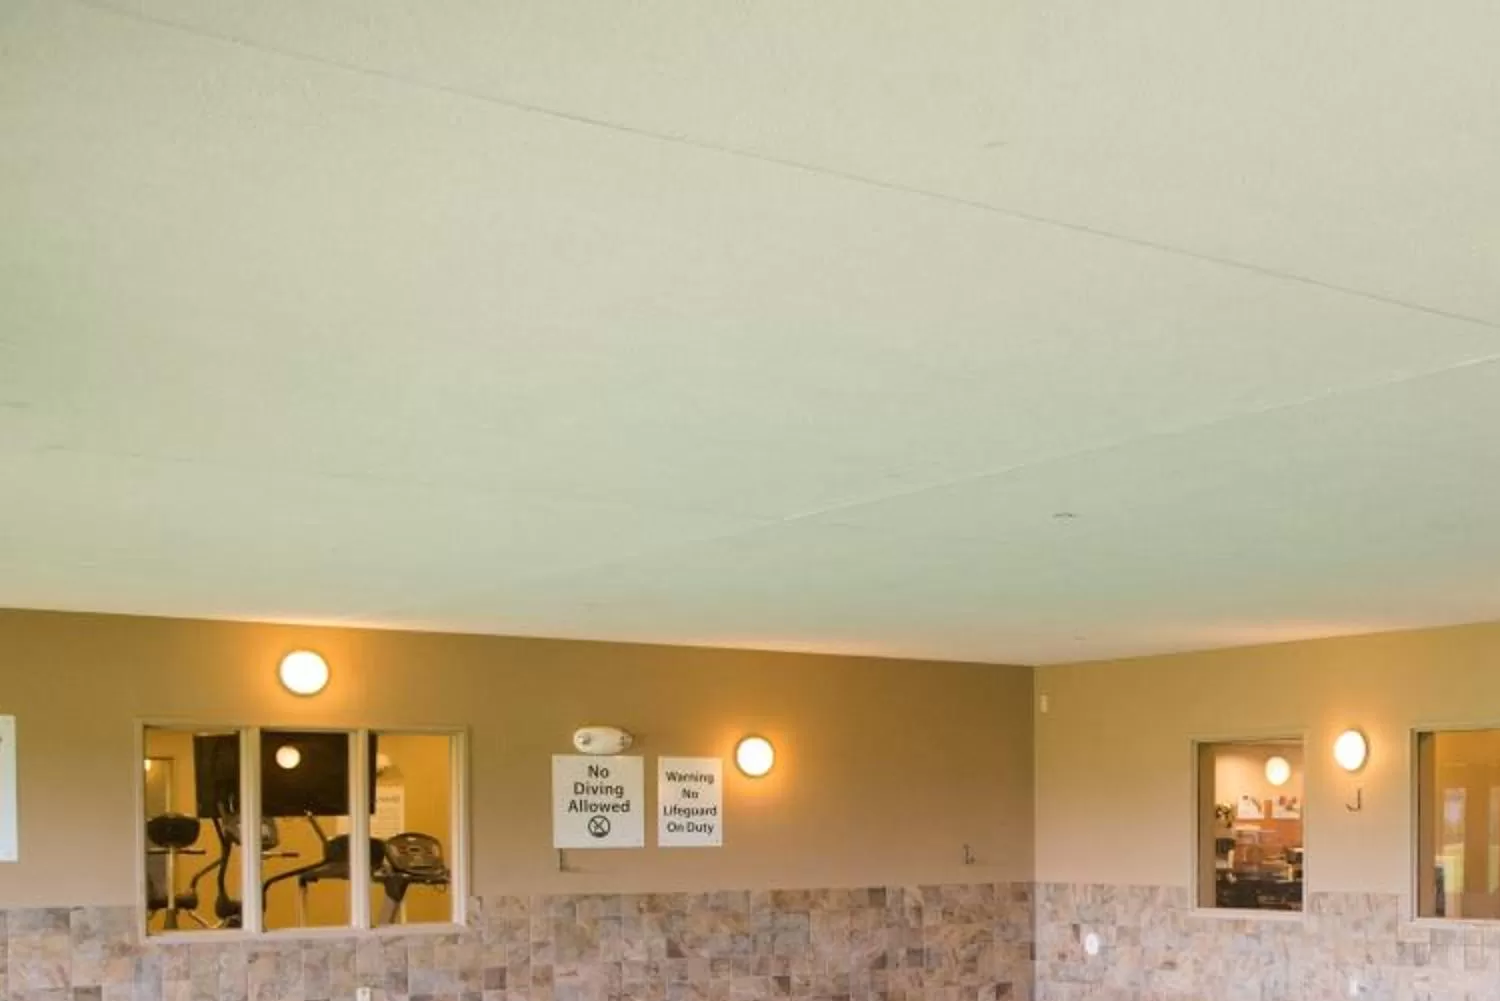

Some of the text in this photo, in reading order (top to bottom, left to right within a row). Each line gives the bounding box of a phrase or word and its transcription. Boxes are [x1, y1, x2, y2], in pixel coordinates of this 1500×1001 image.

[587, 764, 609, 779] No
[665, 771, 715, 785] Warning
[573, 782, 624, 798] Diving
[681, 788, 699, 799] No
[567, 800, 631, 813] Allowed
[663, 805, 717, 819] Lifeguard
[667, 822, 714, 835] On Duty
